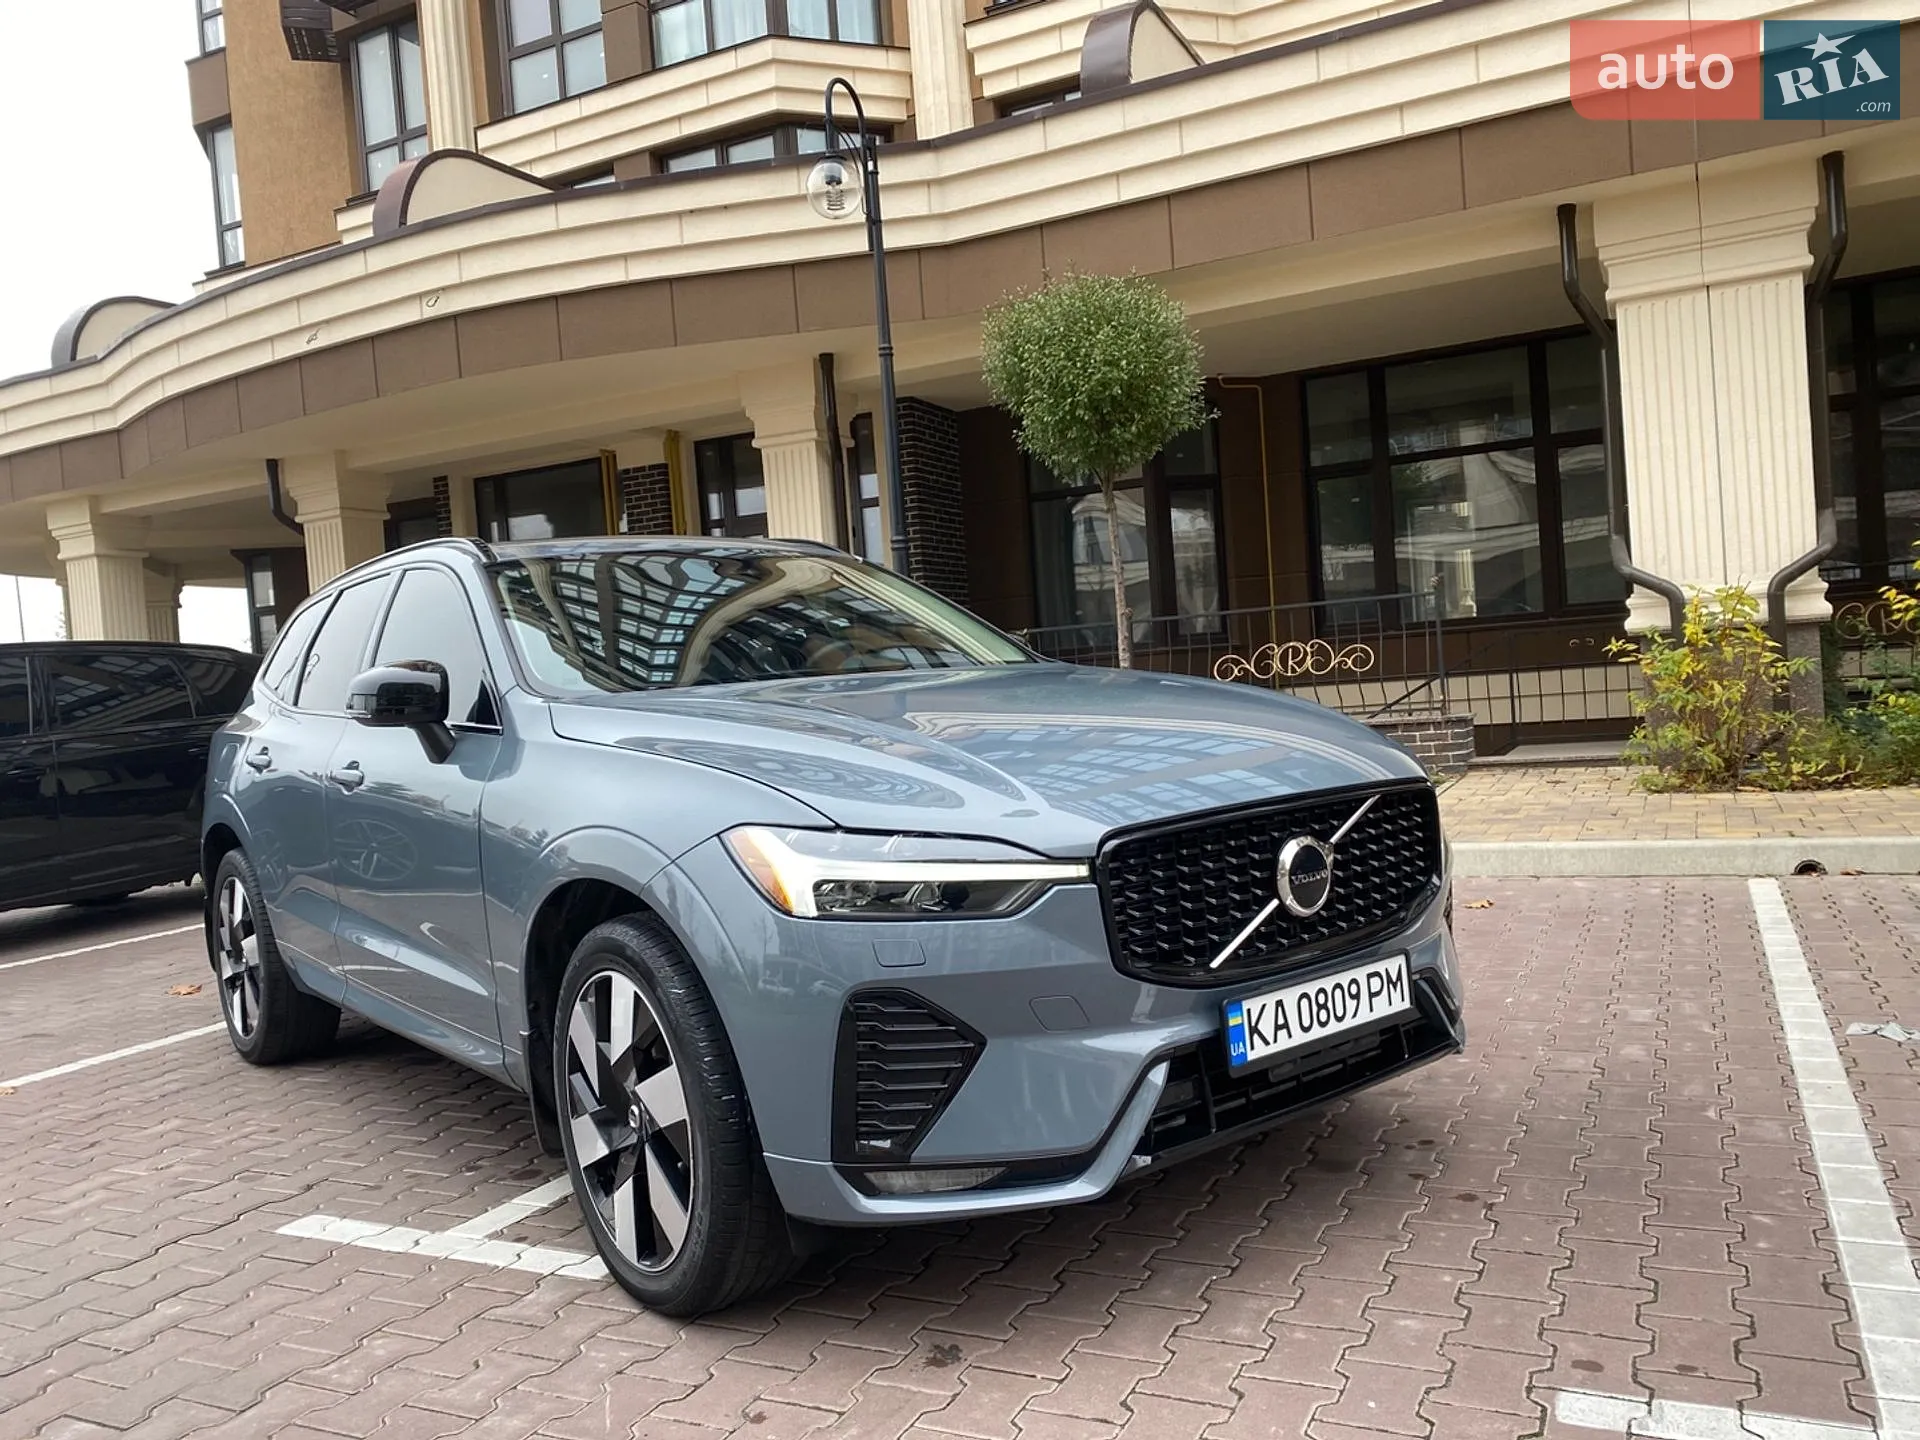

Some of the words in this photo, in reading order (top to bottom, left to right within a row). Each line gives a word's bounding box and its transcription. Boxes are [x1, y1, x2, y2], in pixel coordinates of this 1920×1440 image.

[1290, 868, 1328, 886] VOLVO
[1246, 998, 1293, 1051] KA
[1297, 978, 1361, 1034] 0809
[1366, 963, 1406, 1014] PM
[1230, 1042, 1246, 1057] UA
